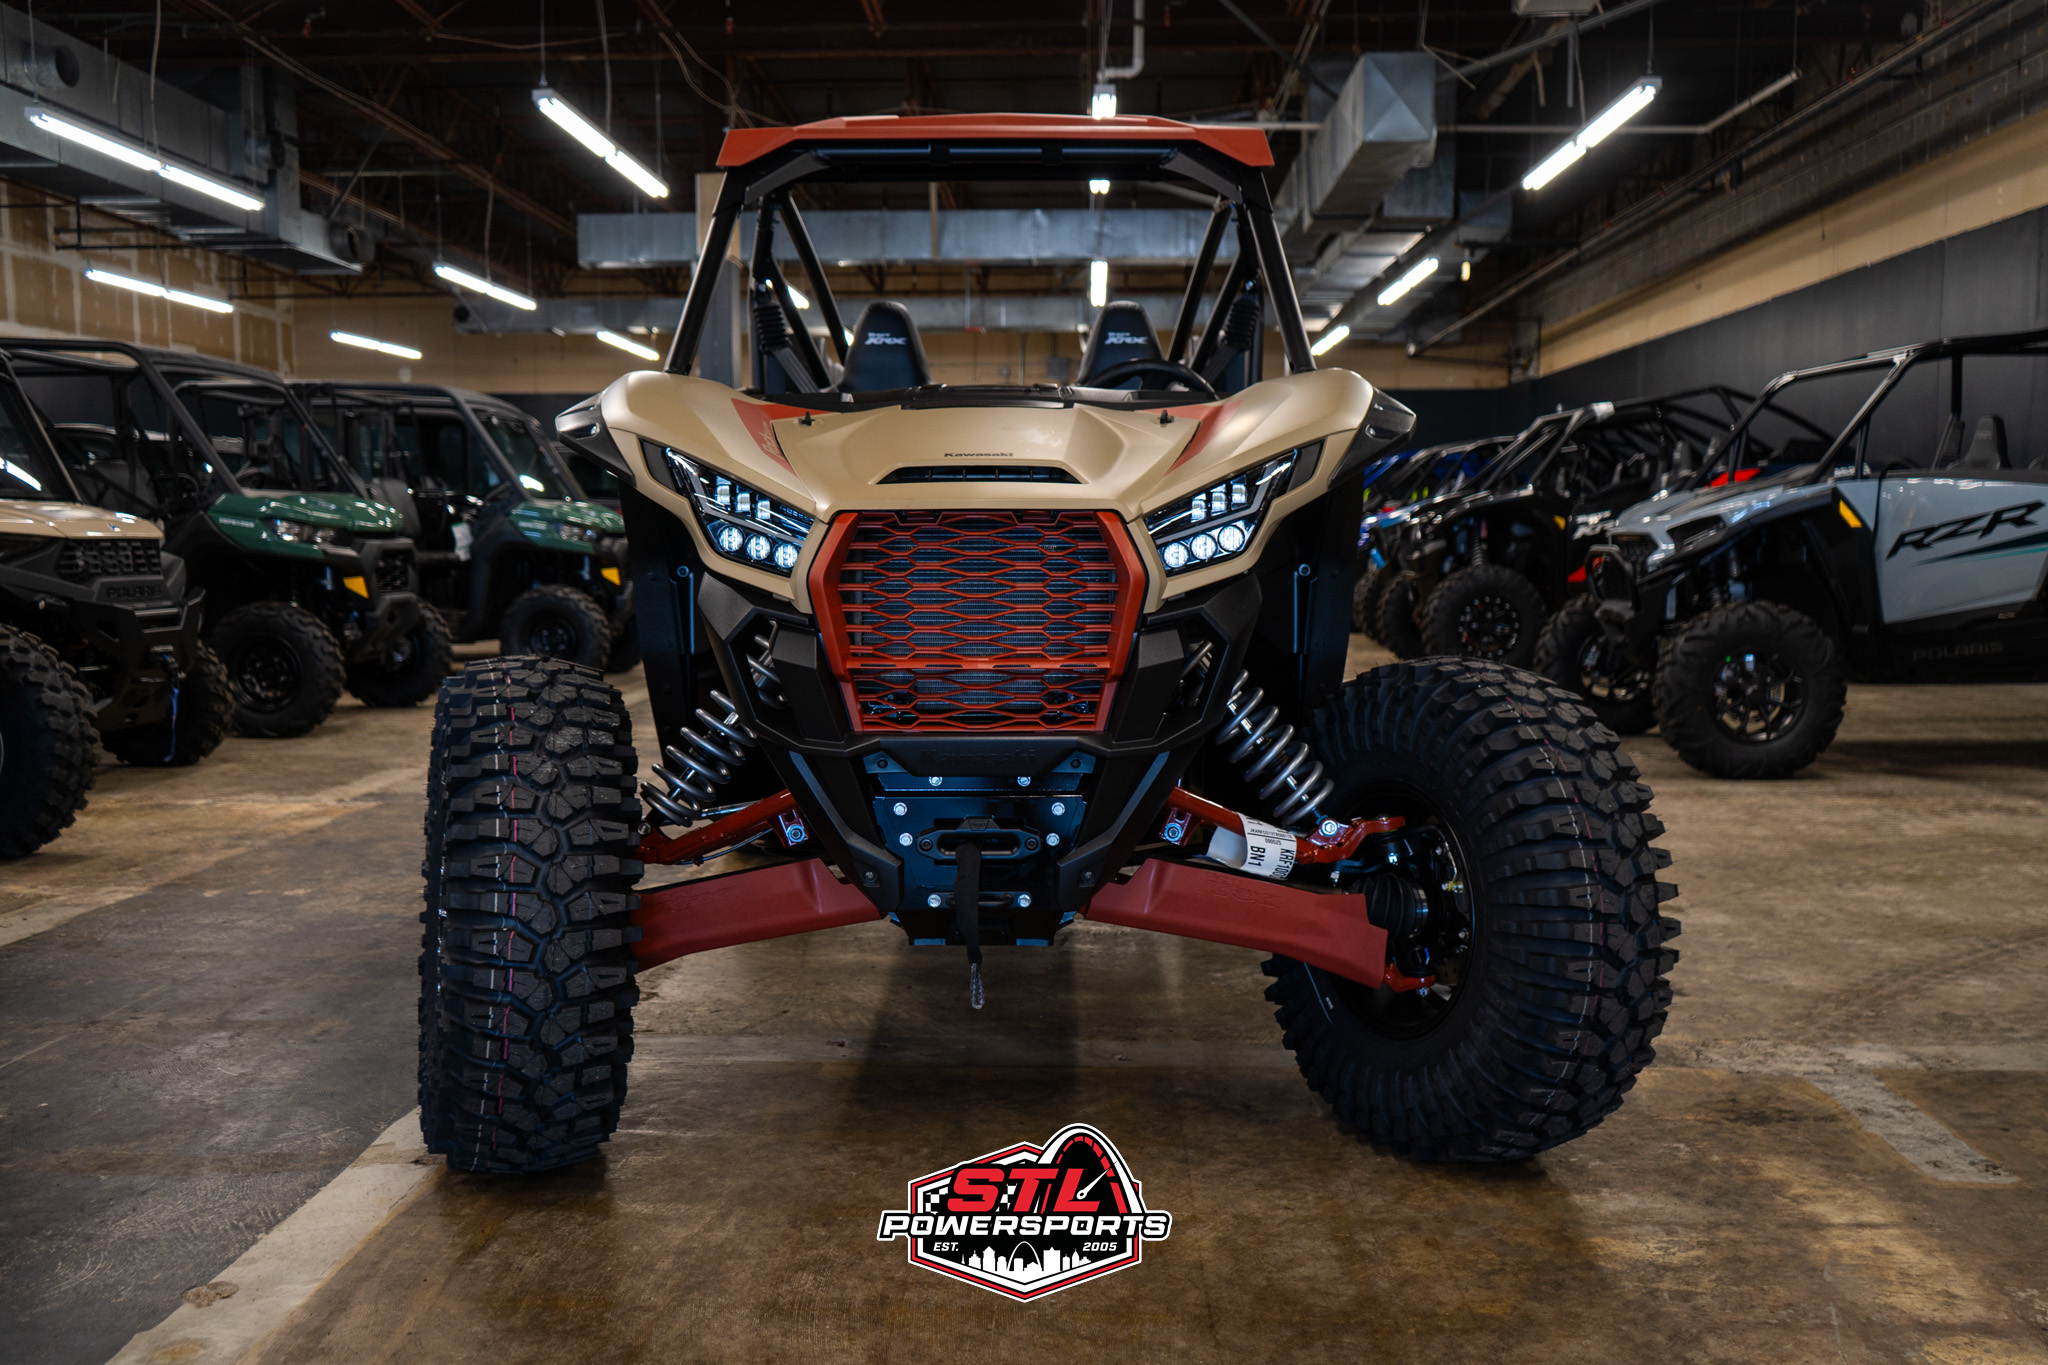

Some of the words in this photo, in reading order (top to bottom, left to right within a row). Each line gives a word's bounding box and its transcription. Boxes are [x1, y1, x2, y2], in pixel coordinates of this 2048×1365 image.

[1885, 499, 2046, 560] RZR
[1912, 641, 2004, 661] POLARIS
[1247, 845, 1266, 867] BN1
